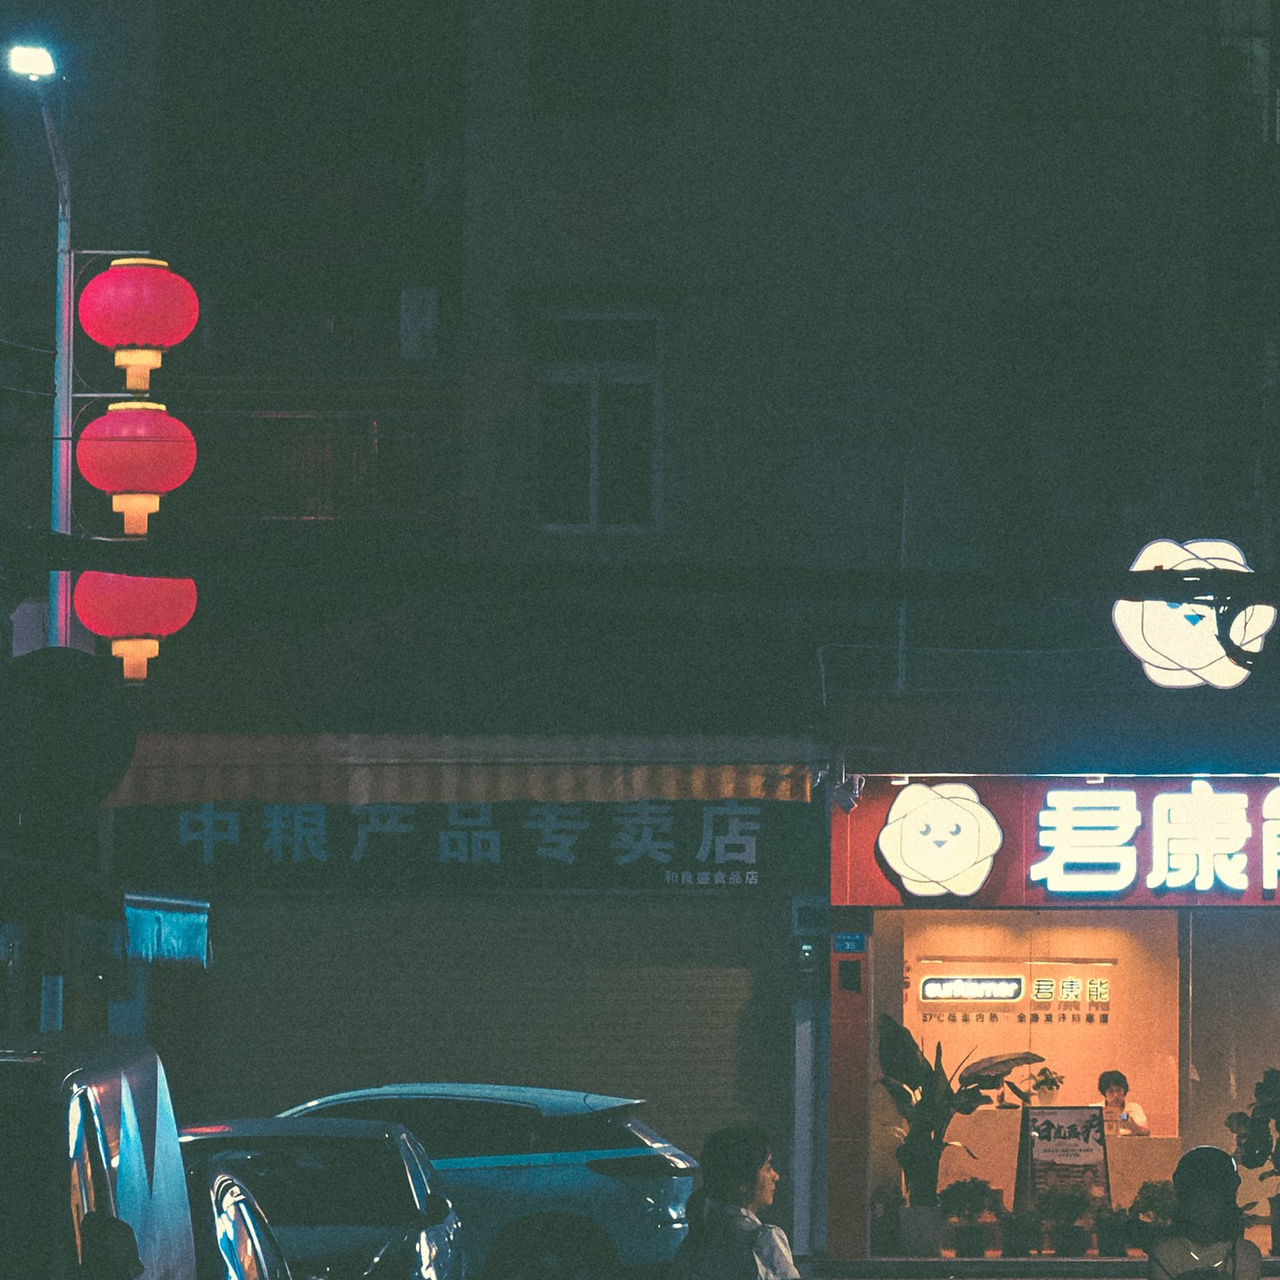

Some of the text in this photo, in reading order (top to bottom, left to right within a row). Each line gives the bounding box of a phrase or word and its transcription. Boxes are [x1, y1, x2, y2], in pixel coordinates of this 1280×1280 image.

[178, 802, 762, 865] 中粮产品专卖店
[1034, 978, 1108, 1000] 君康能
